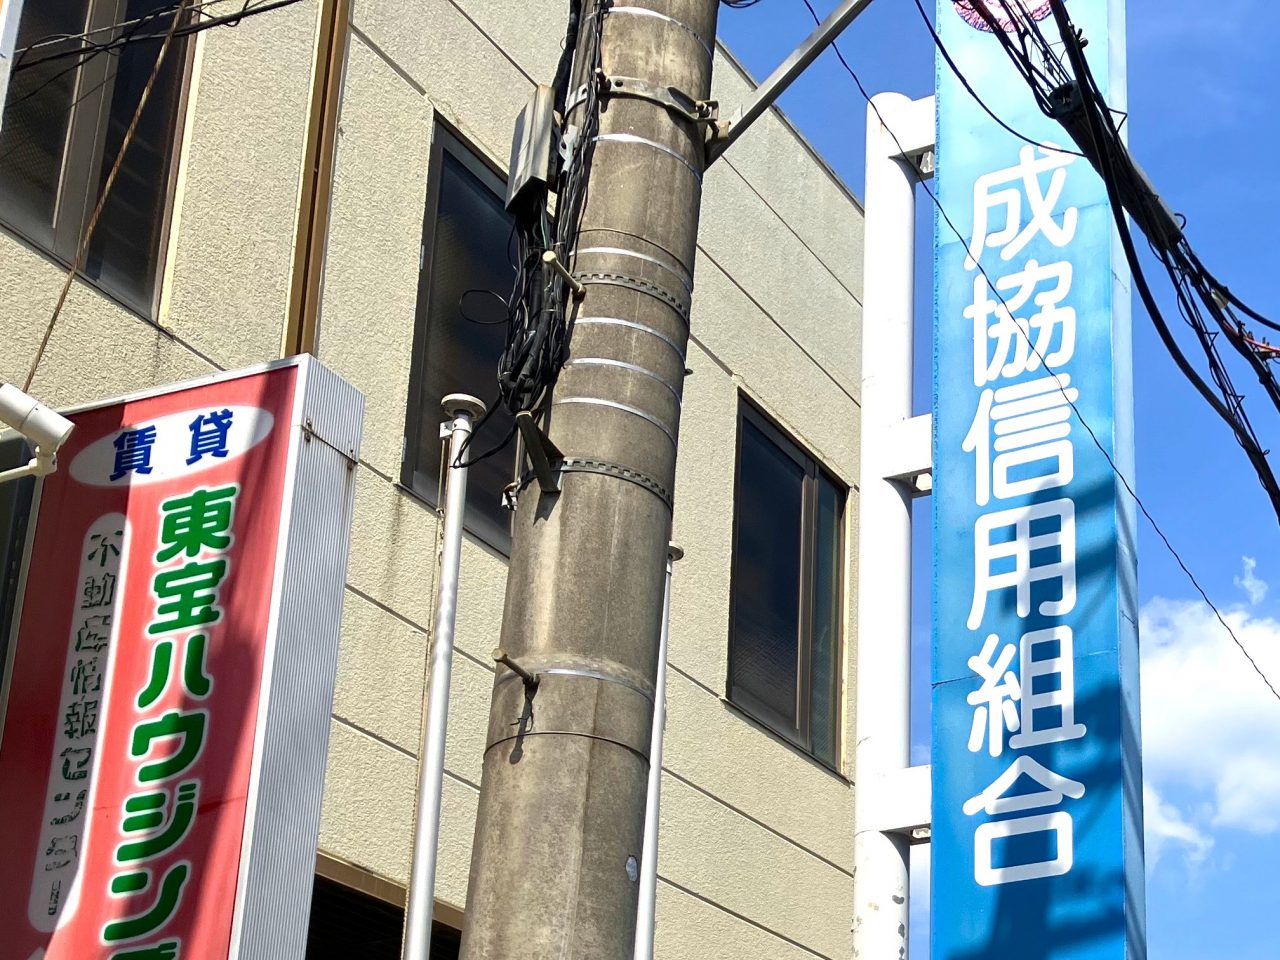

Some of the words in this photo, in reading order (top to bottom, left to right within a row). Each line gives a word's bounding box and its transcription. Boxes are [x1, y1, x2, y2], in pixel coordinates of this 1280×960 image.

[110, 407, 234, 482] 賃貸
[962, 141, 1087, 887] 成協信用組合
